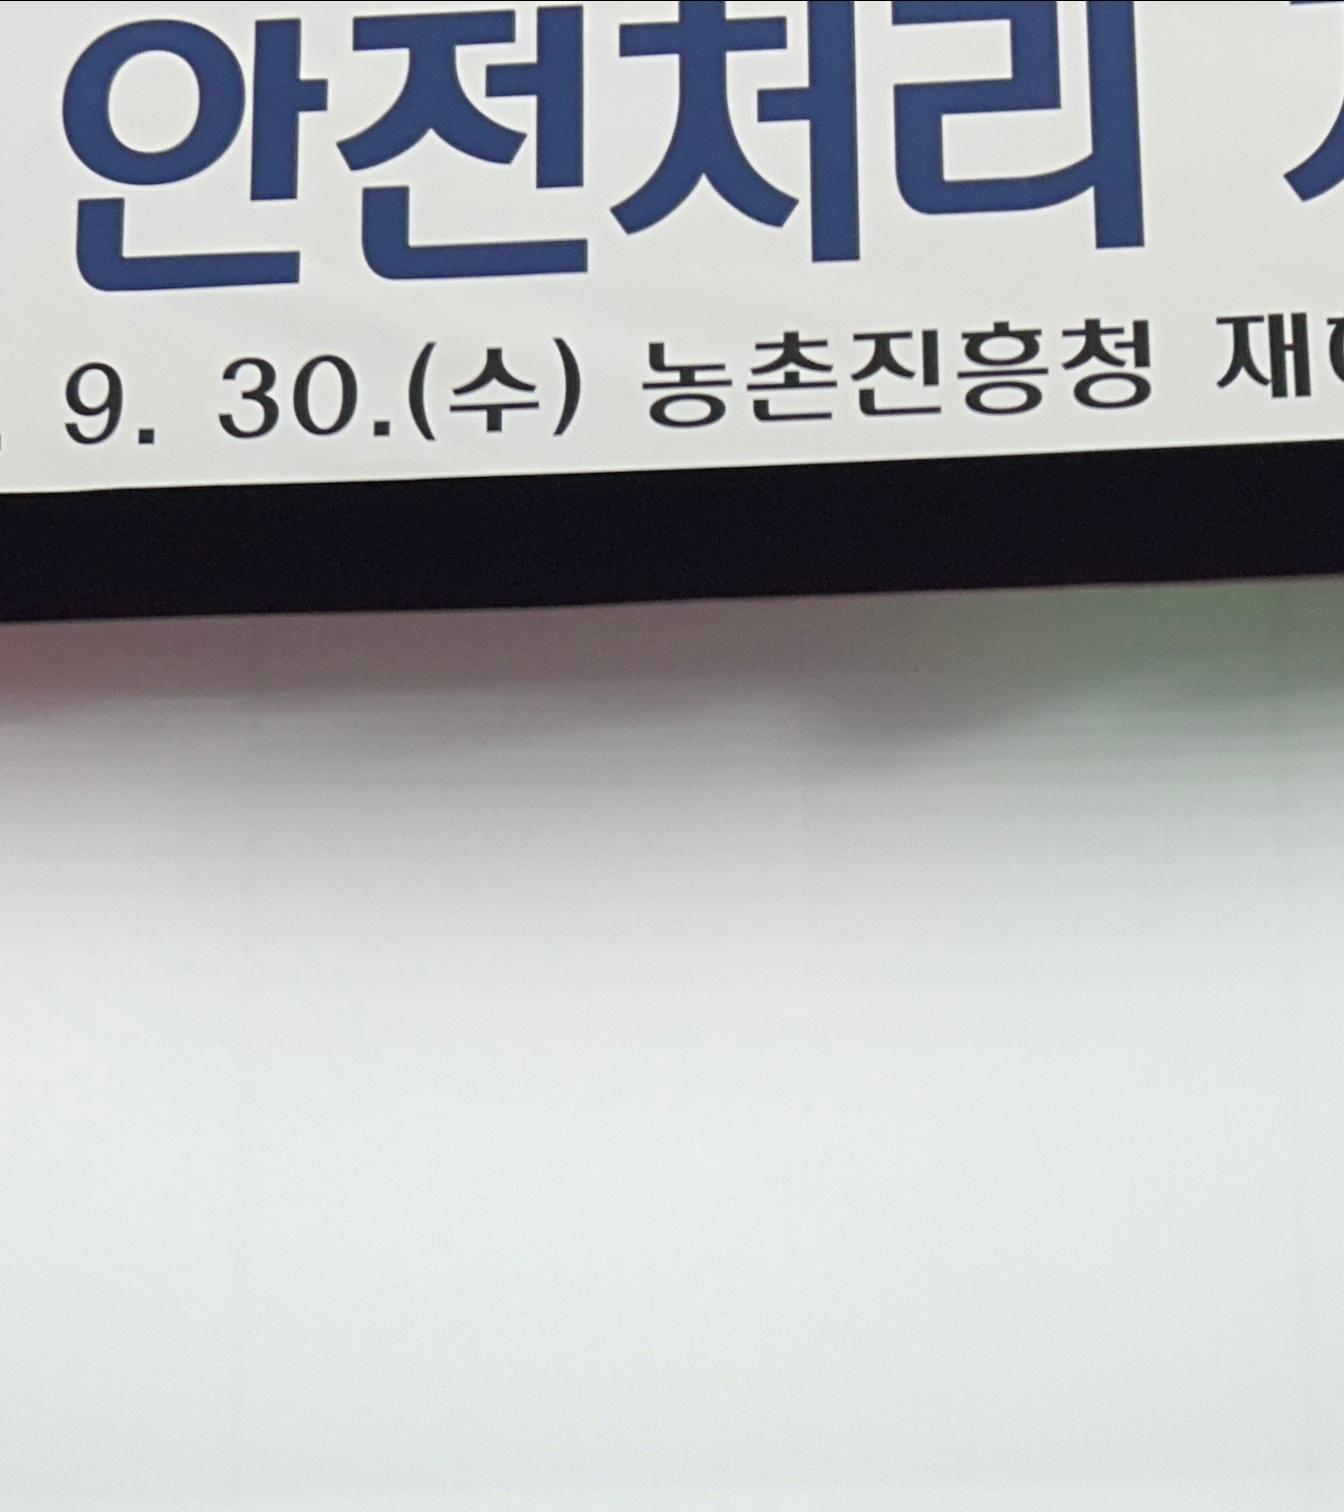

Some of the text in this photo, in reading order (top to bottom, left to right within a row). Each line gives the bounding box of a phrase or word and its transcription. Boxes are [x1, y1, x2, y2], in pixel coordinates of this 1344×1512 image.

[62, 1, 1145, 292] 안전처리
[63, 361, 157, 445] 9.
[217, 336, 582, 441] 30.(수)
[641, 317, 1154, 429] 농촌진흥청
